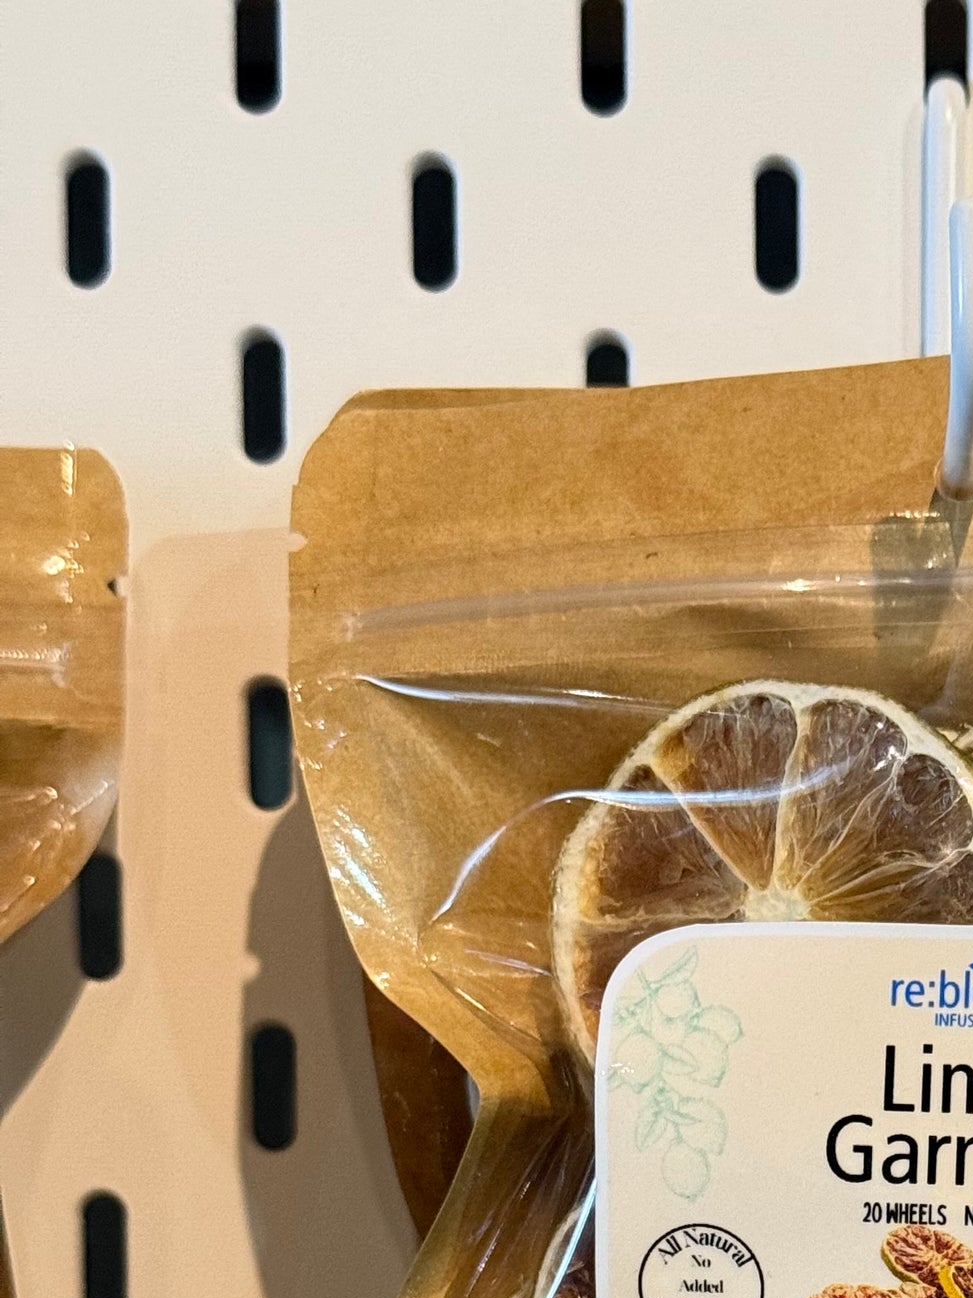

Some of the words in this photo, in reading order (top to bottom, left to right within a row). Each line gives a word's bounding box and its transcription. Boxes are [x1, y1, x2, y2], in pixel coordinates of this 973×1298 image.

[862, 1202, 883, 1224] 20
[886, 1203, 947, 1227] WHEELS
[658, 1235, 683, 1265] All
[683, 1228, 756, 1268] Natural
[691, 1254, 712, 1268] No
[680, 1279, 724, 1294] Added
